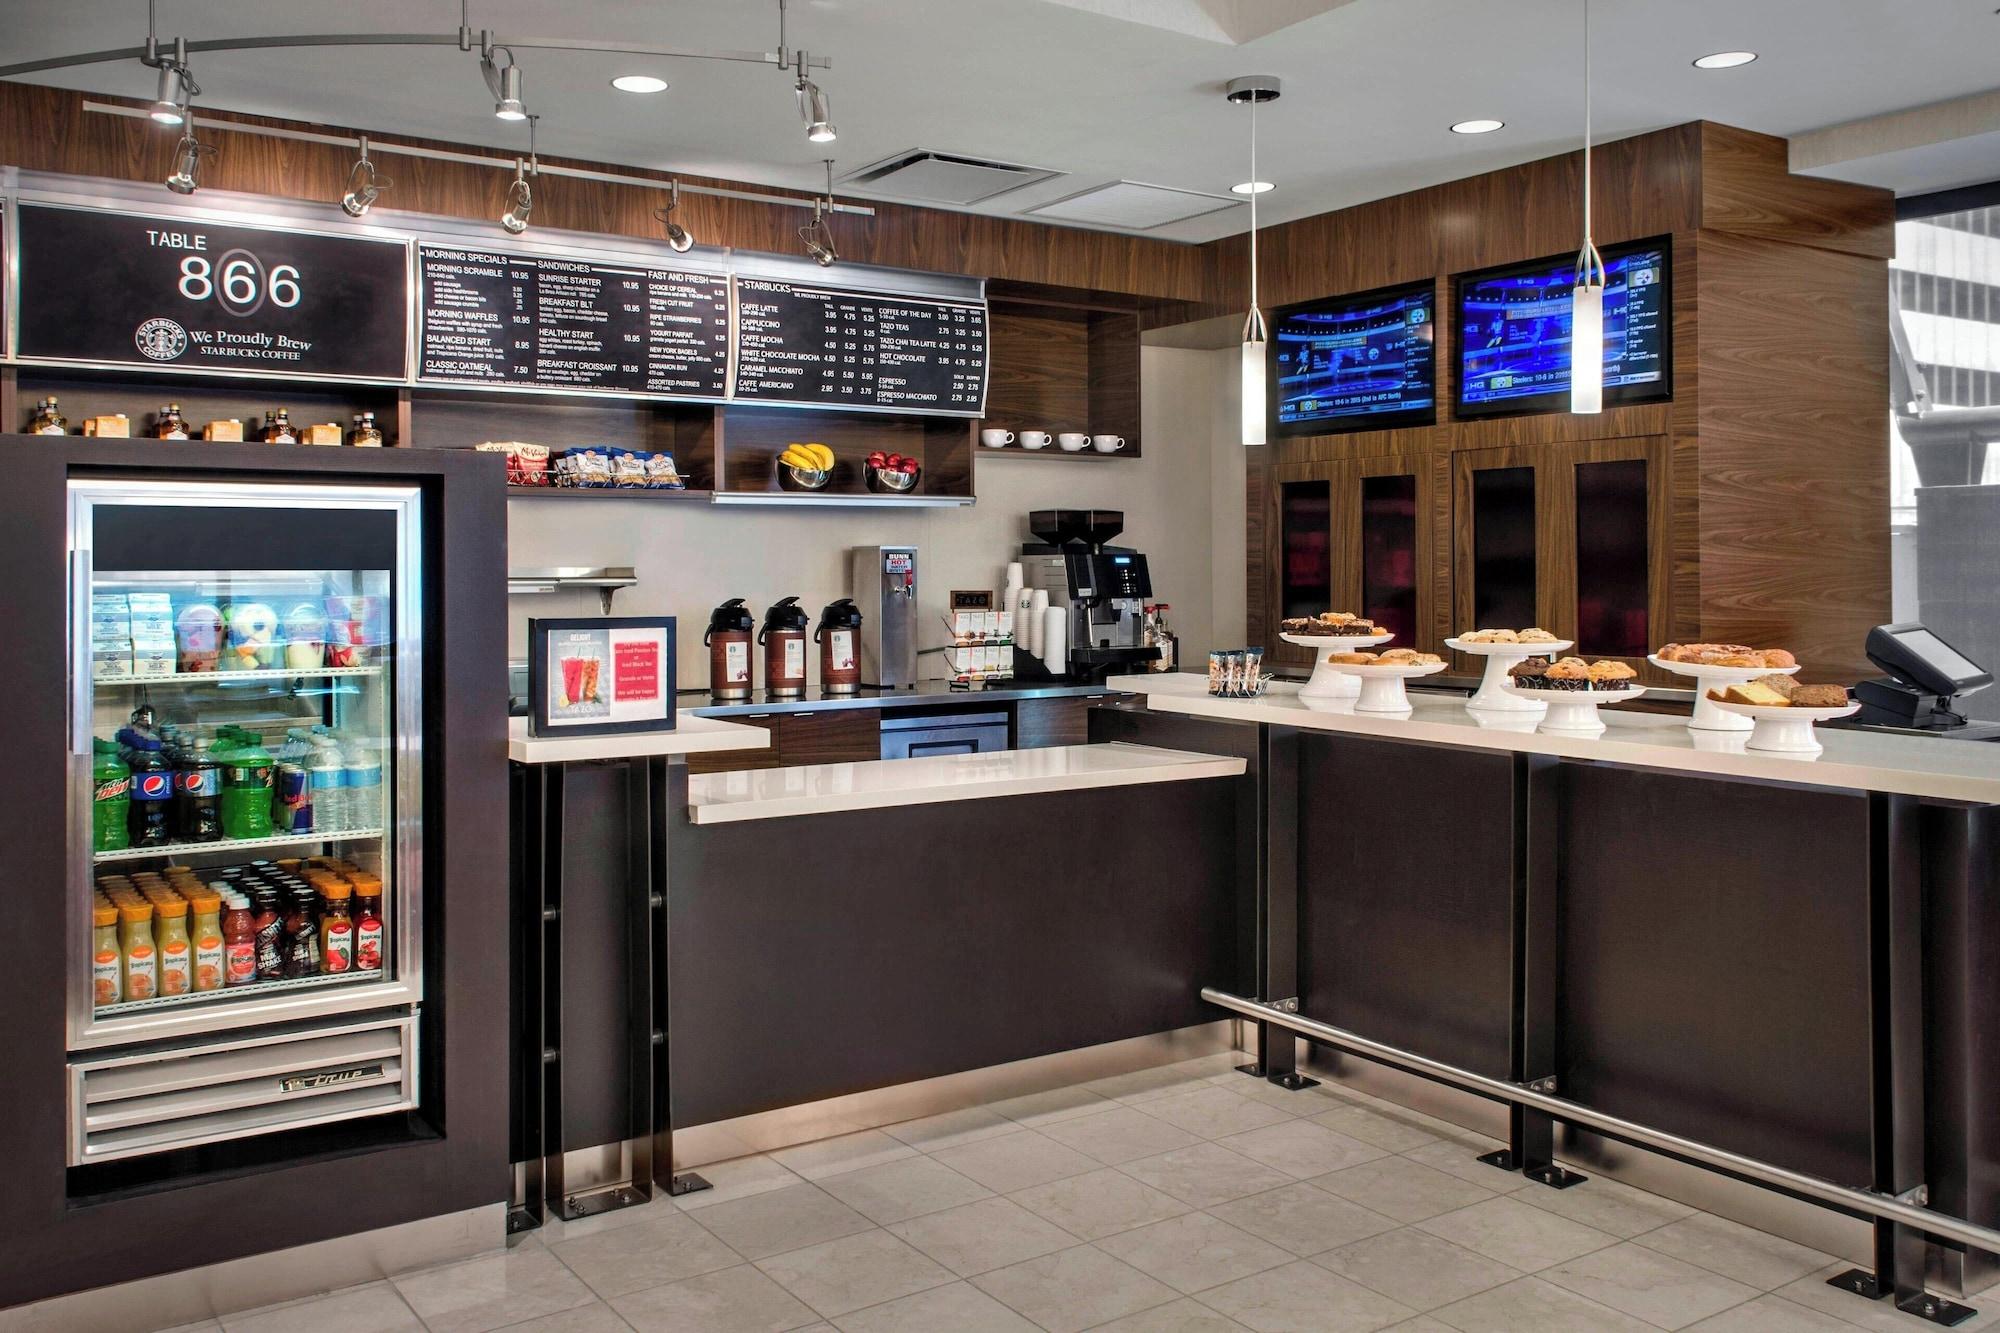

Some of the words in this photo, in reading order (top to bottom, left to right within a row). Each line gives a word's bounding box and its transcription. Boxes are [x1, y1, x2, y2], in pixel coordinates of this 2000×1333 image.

[146, 230, 207, 250] TABLE
[426, 250, 466, 260] MORNING
[468, 253, 507, 264] SPECIALS
[427, 263, 462, 274] MORNING
[464, 267, 503, 278] SCRAMBLE
[511, 271, 529, 280] 10.95
[538, 260, 590, 273] SANDWICHES
[178, 256, 300, 308] 866
[538, 274, 569, 283] SUNRISE
[570, 277, 601, 286] STARTER
[622, 281, 639, 289] 10.95
[648, 271, 667, 280] FAST
[668, 273, 684, 282] AND
[685, 275, 709, 284] FRESH
[745, 280, 791, 293] STARBUCKS
[539, 297, 579, 307] BREAKFAST
[580, 301, 593, 309] BLT
[624, 304, 640, 312] 10.95
[741, 303, 759, 311] CAFFE
[760, 305, 779, 313] LATTE
[825, 311, 836, 319] 3.95
[427, 309, 463, 319] MORNING
[464, 312, 498, 321] WAFFLES
[513, 316, 530, 324] 10.95
[879, 308, 900, 316] COFFEE
[662, 315, 702, 324] STRAWBERRIES
[139, 319, 184, 339] STARBUCKS
[539, 328, 570, 337] HEALTHY
[572, 331, 594, 339] START
[741, 318, 780, 329] CAPPUCCINO
[863, 329, 875, 337] 5.25
[190, 331, 213, 343] We
[216, 331, 273, 348] Proudly
[278, 335, 312, 351] Brew
[427, 335, 466, 344] BALANCED
[468, 338, 491, 346] START
[515, 341, 530, 349] 8.95
[741, 334, 759, 342] CAFFE
[761, 336, 784, 344] MOCHA
[845, 342, 856, 350] 5.25
[863, 344, 875, 352] 5.75
[895, 338, 909, 346] CHAI
[143, 346, 177, 360] COFFEE
[201, 346, 260, 358] STARBUCKS
[262, 350, 301, 360] COFFEE
[740, 349, 760, 357] WHITE
[761, 351, 796, 360] CHOCOLATE
[798, 353, 820, 361] MOCHA
[863, 357, 874, 365] 5.75
[893, 354, 926, 363] CHOCOLATE
[426, 360, 457, 368] CLASSIC
[459, 362, 493, 371] OATMEAL
[514, 366, 528, 374] 7.50
[537, 359, 577, 369] BREAKFAST
[578, 362, 617, 371] CROISSANT
[622, 365, 639, 373] 10.95
[740, 364, 768, 372] CARAMEL
[769, 367, 803, 375] MACCHIATO
[843, 371, 854, 379] 5.50
[861, 372, 873, 380] 5.95
[759, 382, 794, 390] AMERICANO
[841, 386, 853, 394] 3.50
[860, 387, 872, 395] 3.75
[878, 377, 906, 385] ESPRESSO
[953, 382, 964, 390] 2.50
[906, 393, 937, 401] MACCHIATO
